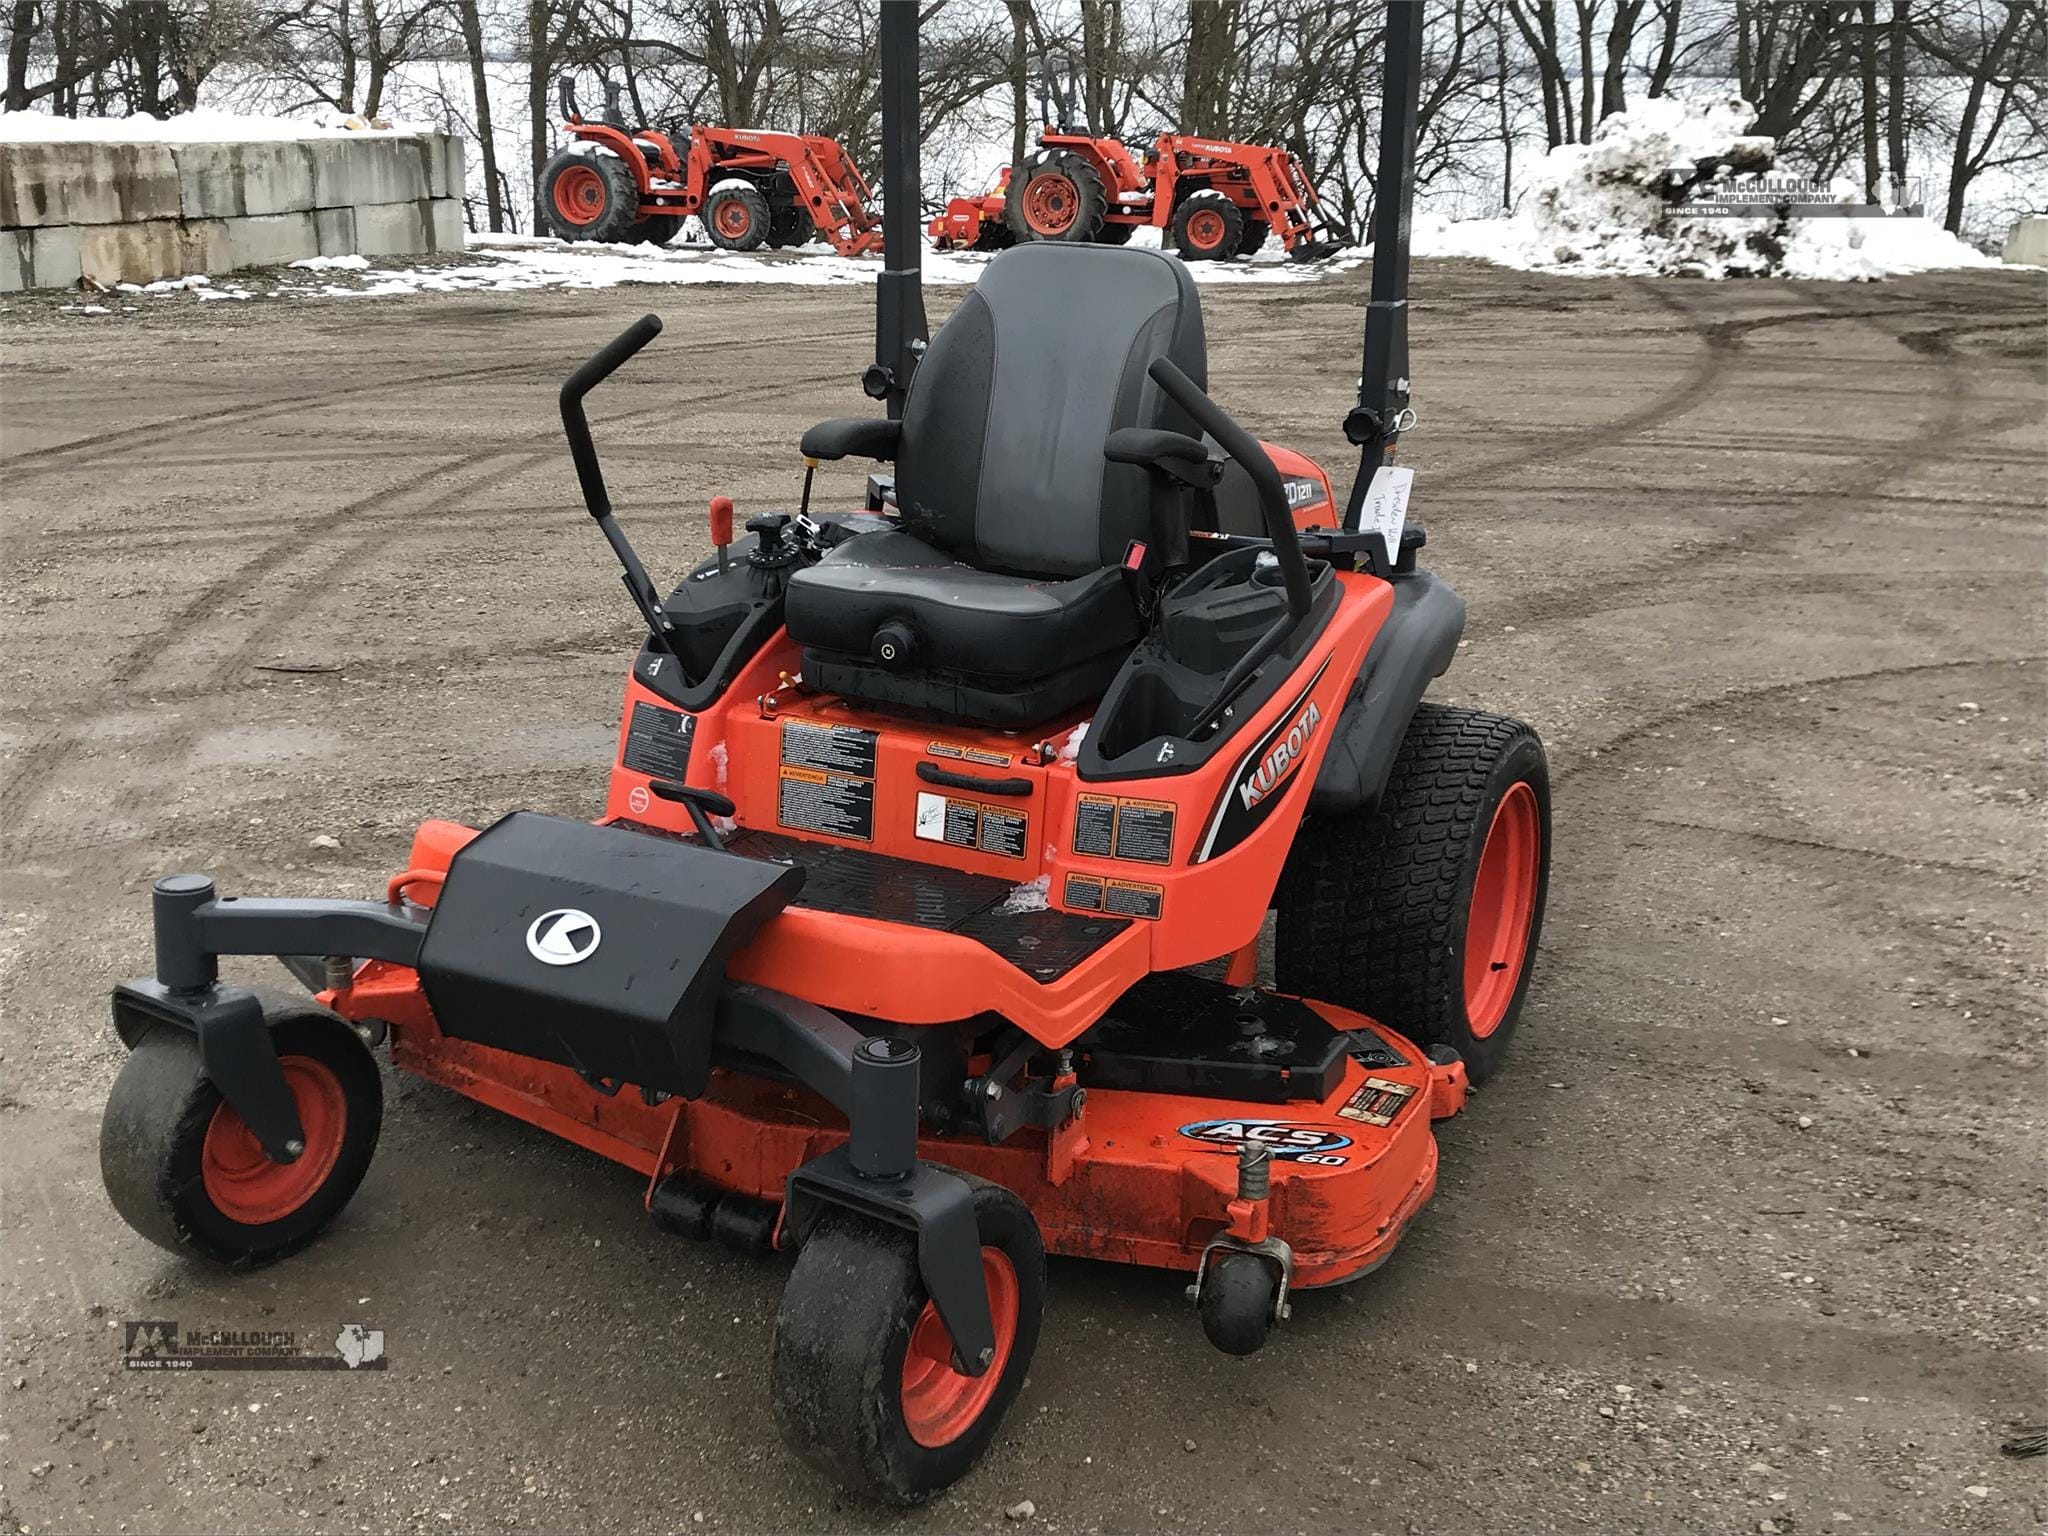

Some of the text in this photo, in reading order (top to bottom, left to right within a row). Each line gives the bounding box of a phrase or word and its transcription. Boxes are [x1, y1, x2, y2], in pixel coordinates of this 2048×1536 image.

[1205, 145, 1233, 153] KUBOTA
[1373, 494, 1386, 524] Trade
[1239, 701, 1321, 811] KUBOTA
[1203, 1122, 1329, 1145] ACS
[1296, 1153, 1347, 1166] 60
